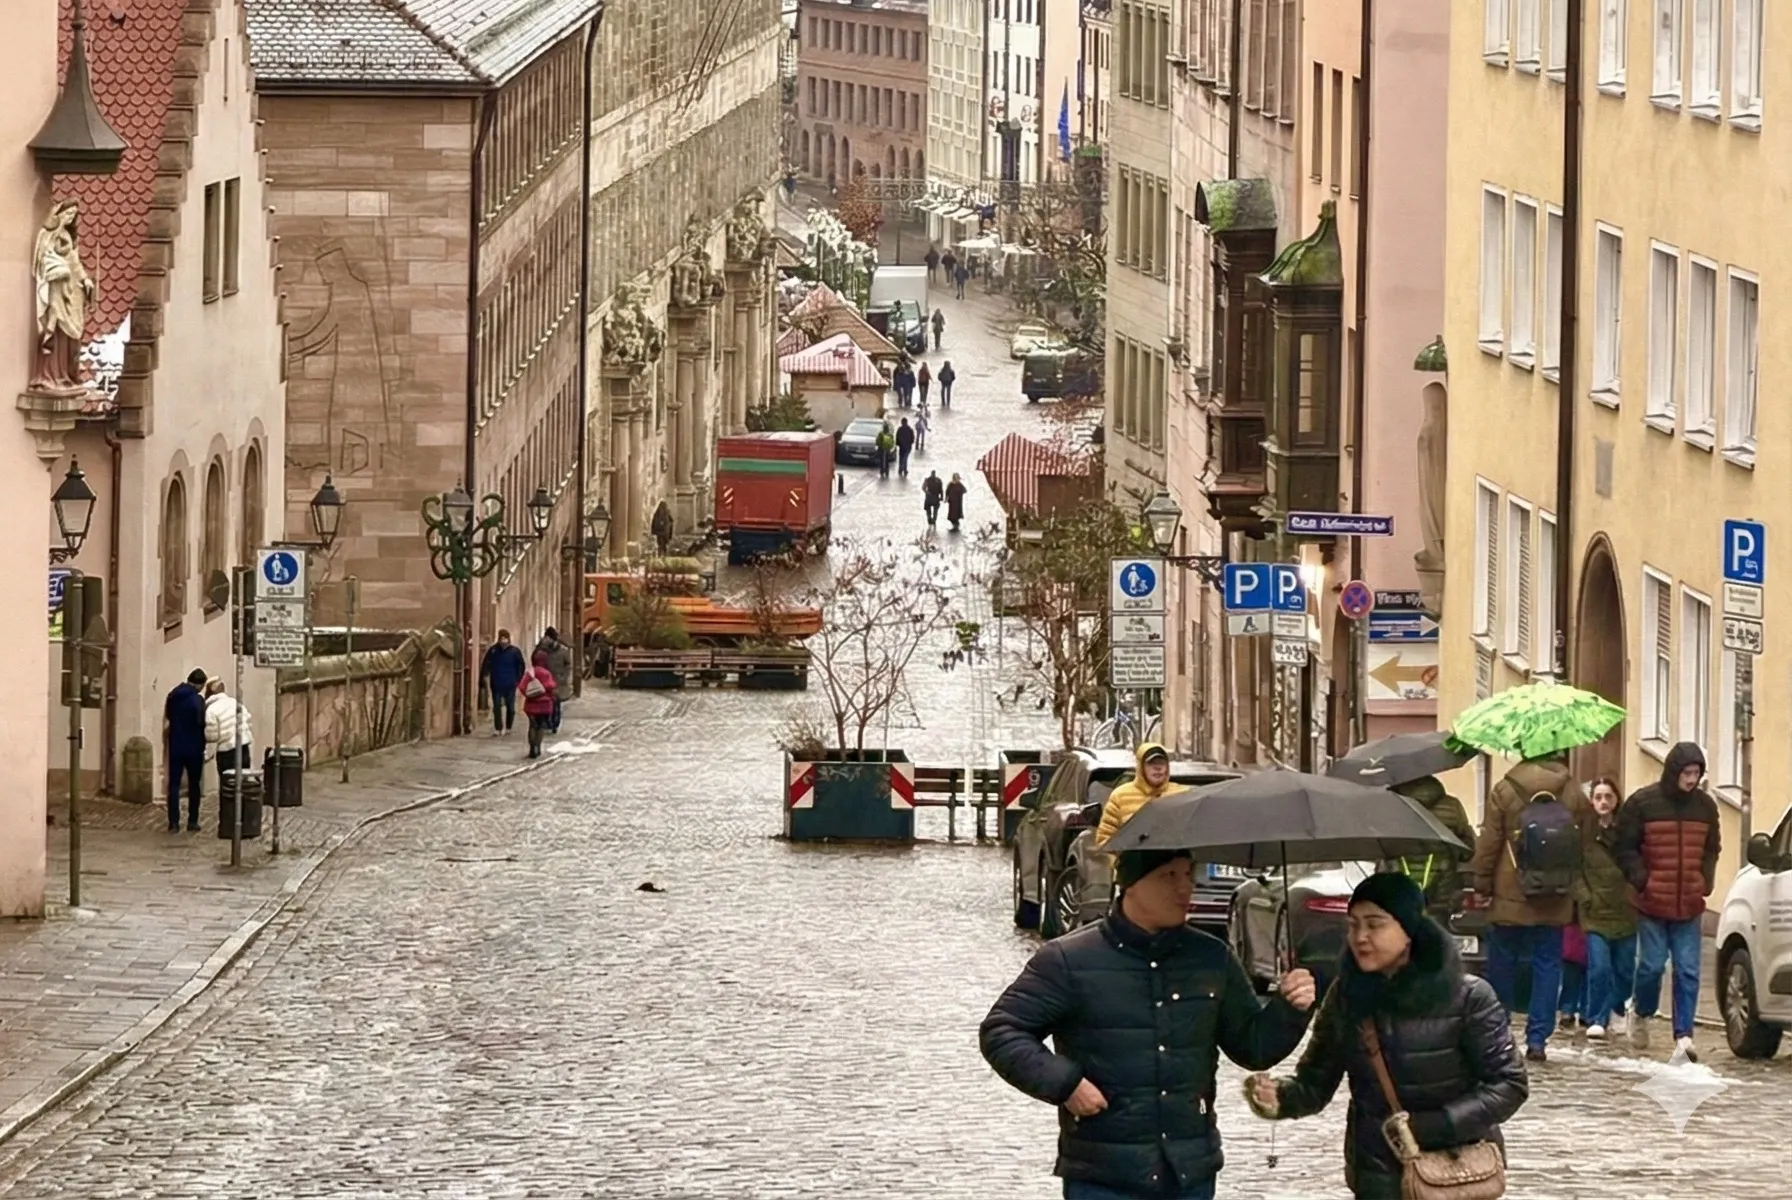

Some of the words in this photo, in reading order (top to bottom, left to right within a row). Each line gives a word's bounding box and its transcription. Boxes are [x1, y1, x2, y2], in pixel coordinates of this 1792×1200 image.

[1732, 528, 1755, 571] P
[1235, 570, 1259, 604] P
[1279, 571, 1297, 604] P
